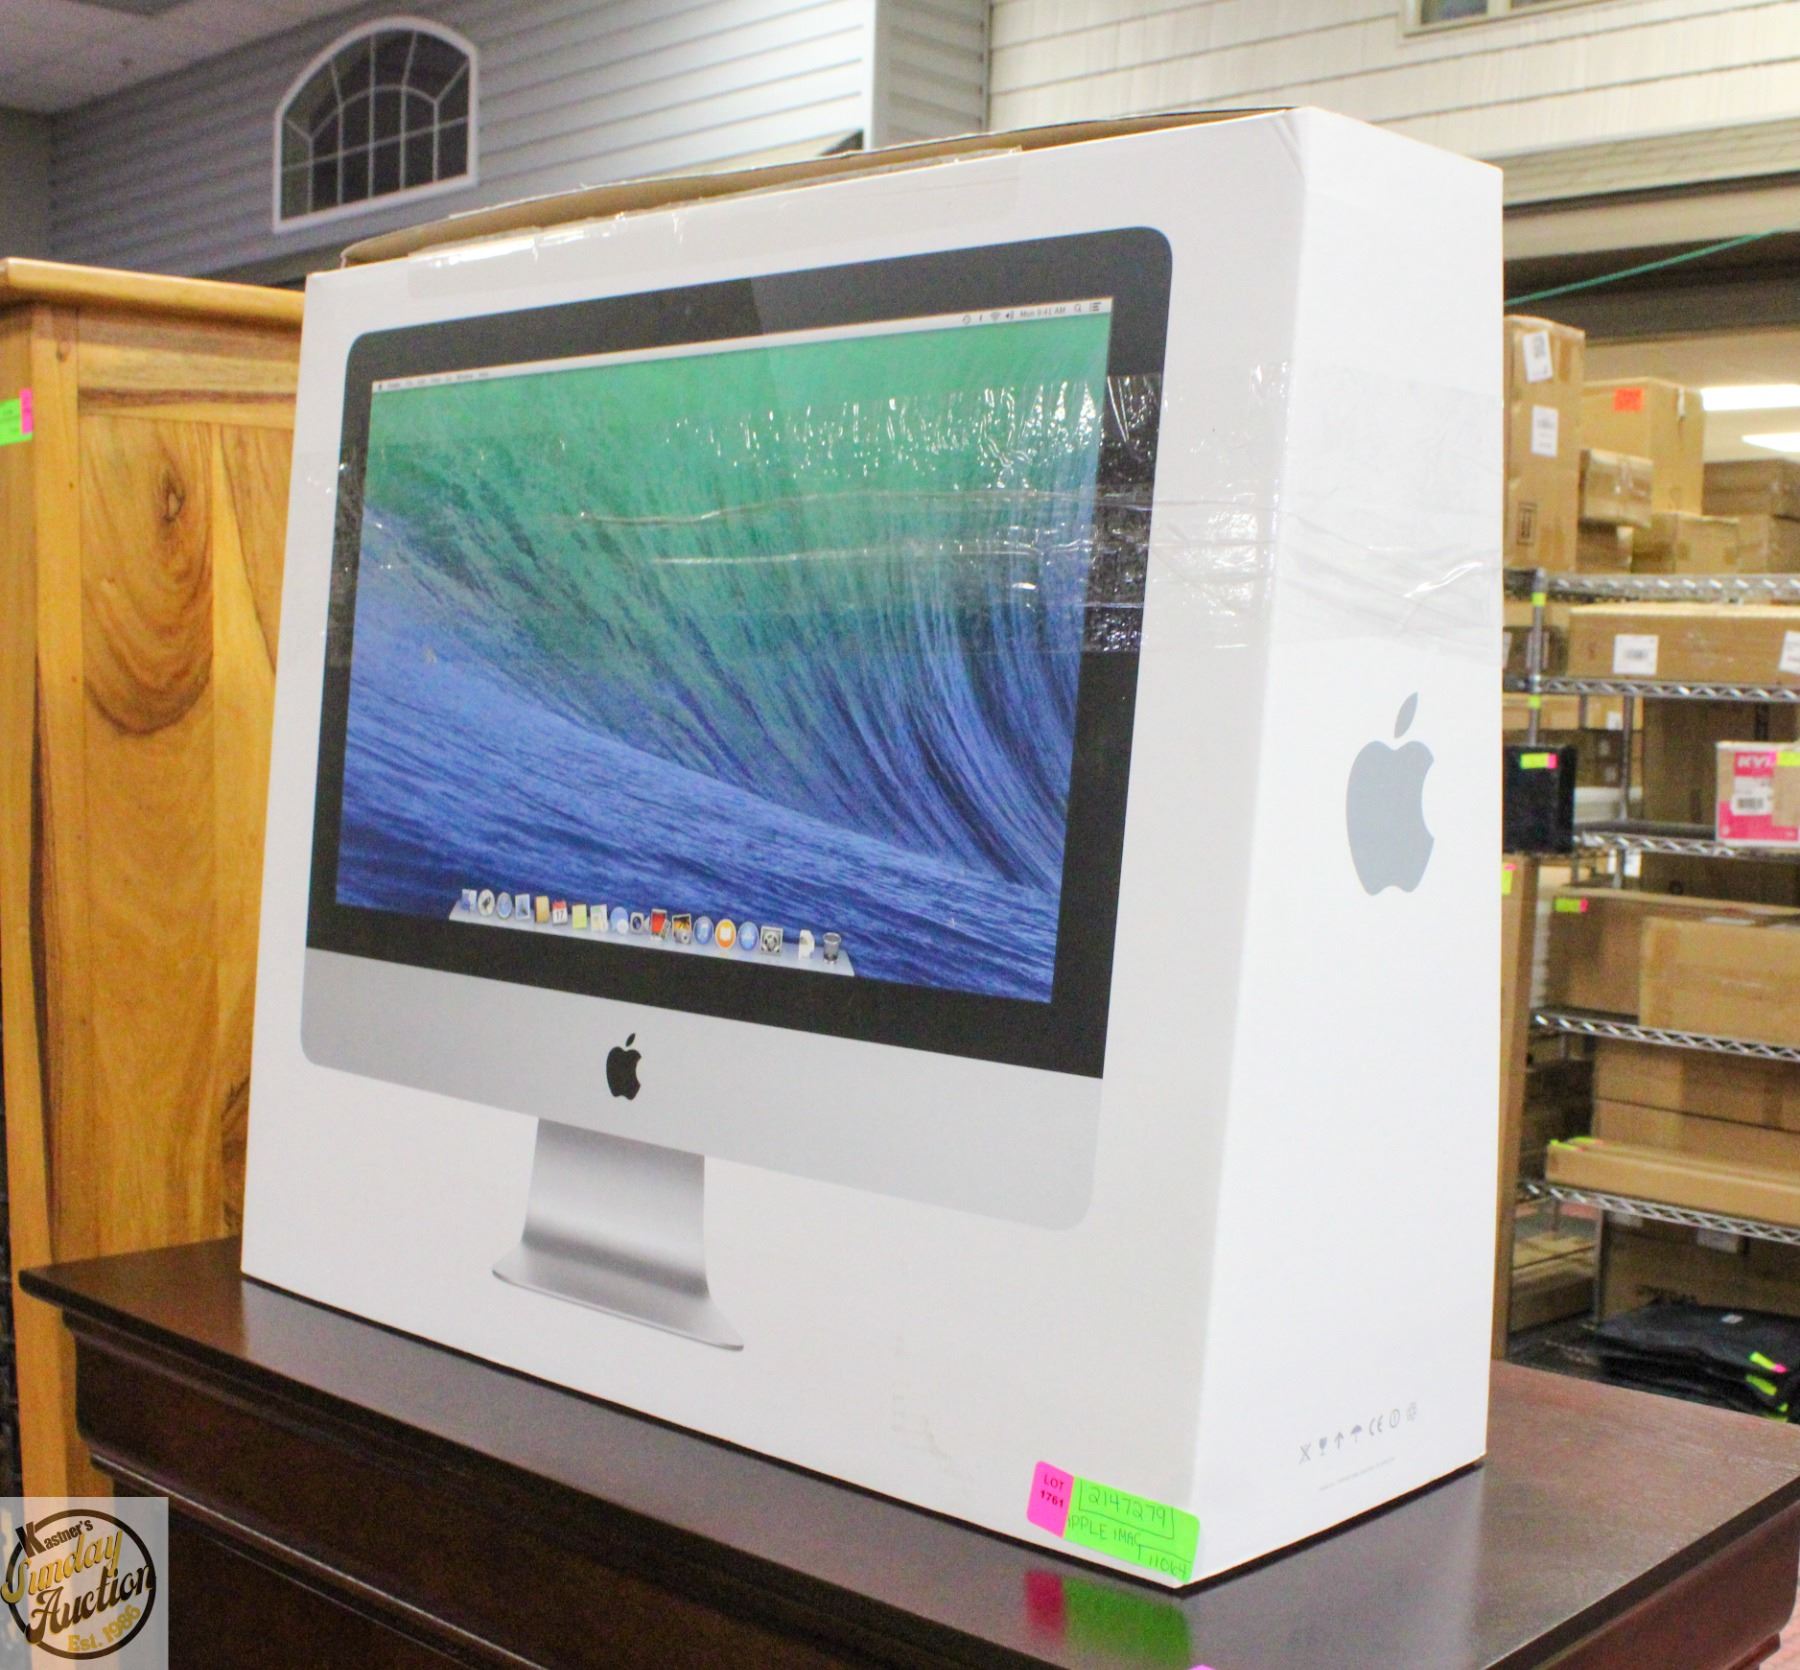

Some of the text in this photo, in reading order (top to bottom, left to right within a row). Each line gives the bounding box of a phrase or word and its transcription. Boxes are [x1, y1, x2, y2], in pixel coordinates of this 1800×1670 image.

[1043, 1474, 1064, 1491] LOT
[1040, 1490, 1064, 1508] 1761
[1088, 1486, 1166, 1528] 2147279
